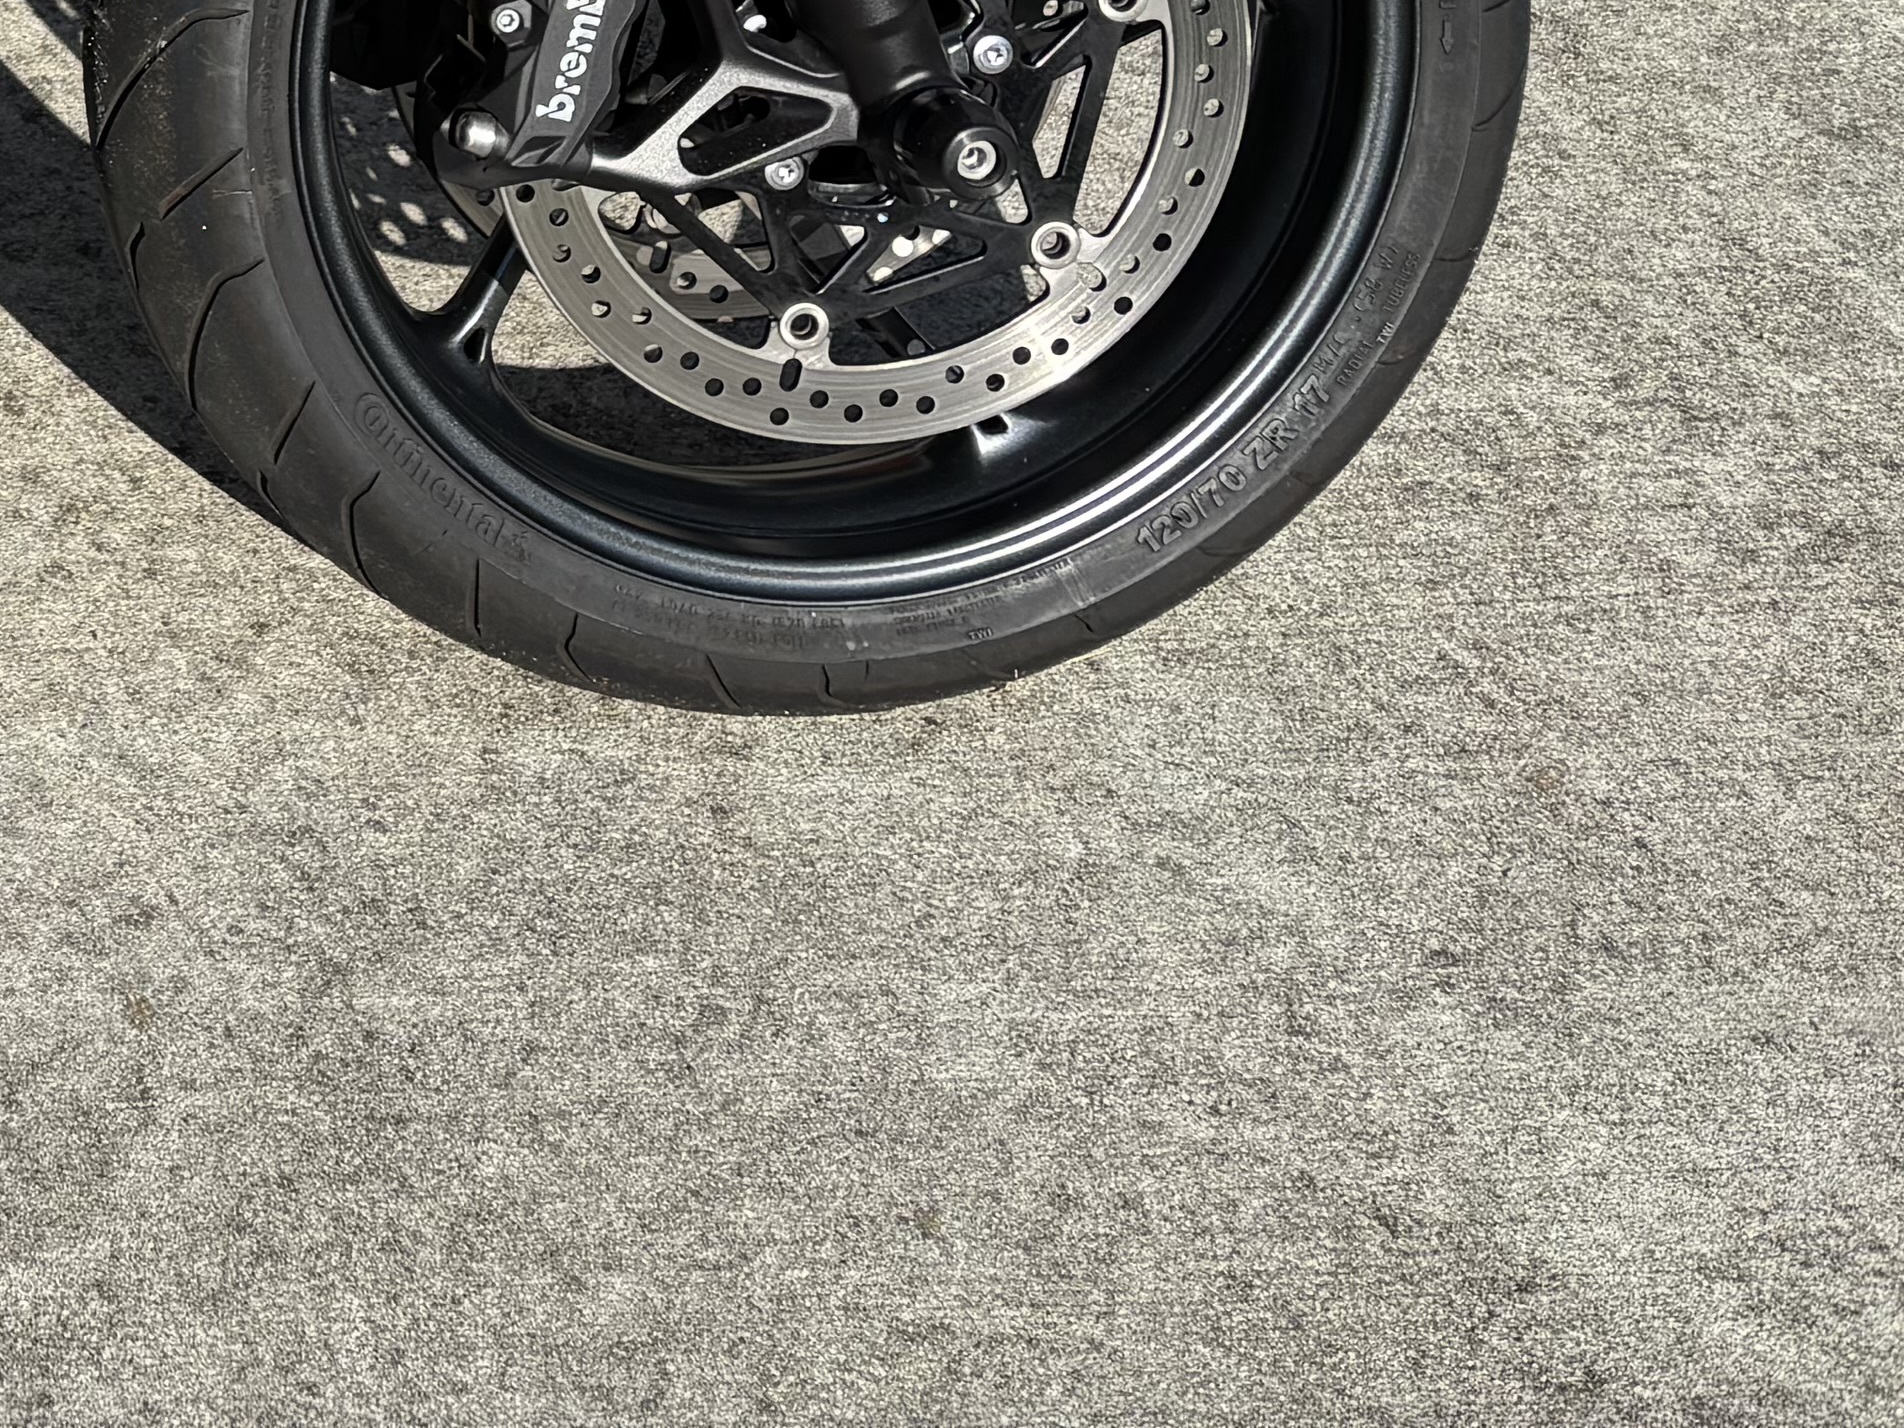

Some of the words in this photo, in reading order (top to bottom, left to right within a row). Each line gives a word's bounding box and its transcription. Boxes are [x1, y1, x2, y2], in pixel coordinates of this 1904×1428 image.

[354, 392, 514, 546] Continental
[1136, 463, 1248, 554] 120/70
[1242, 416, 1299, 471] ZR
[1291, 375, 1332, 421] 17
